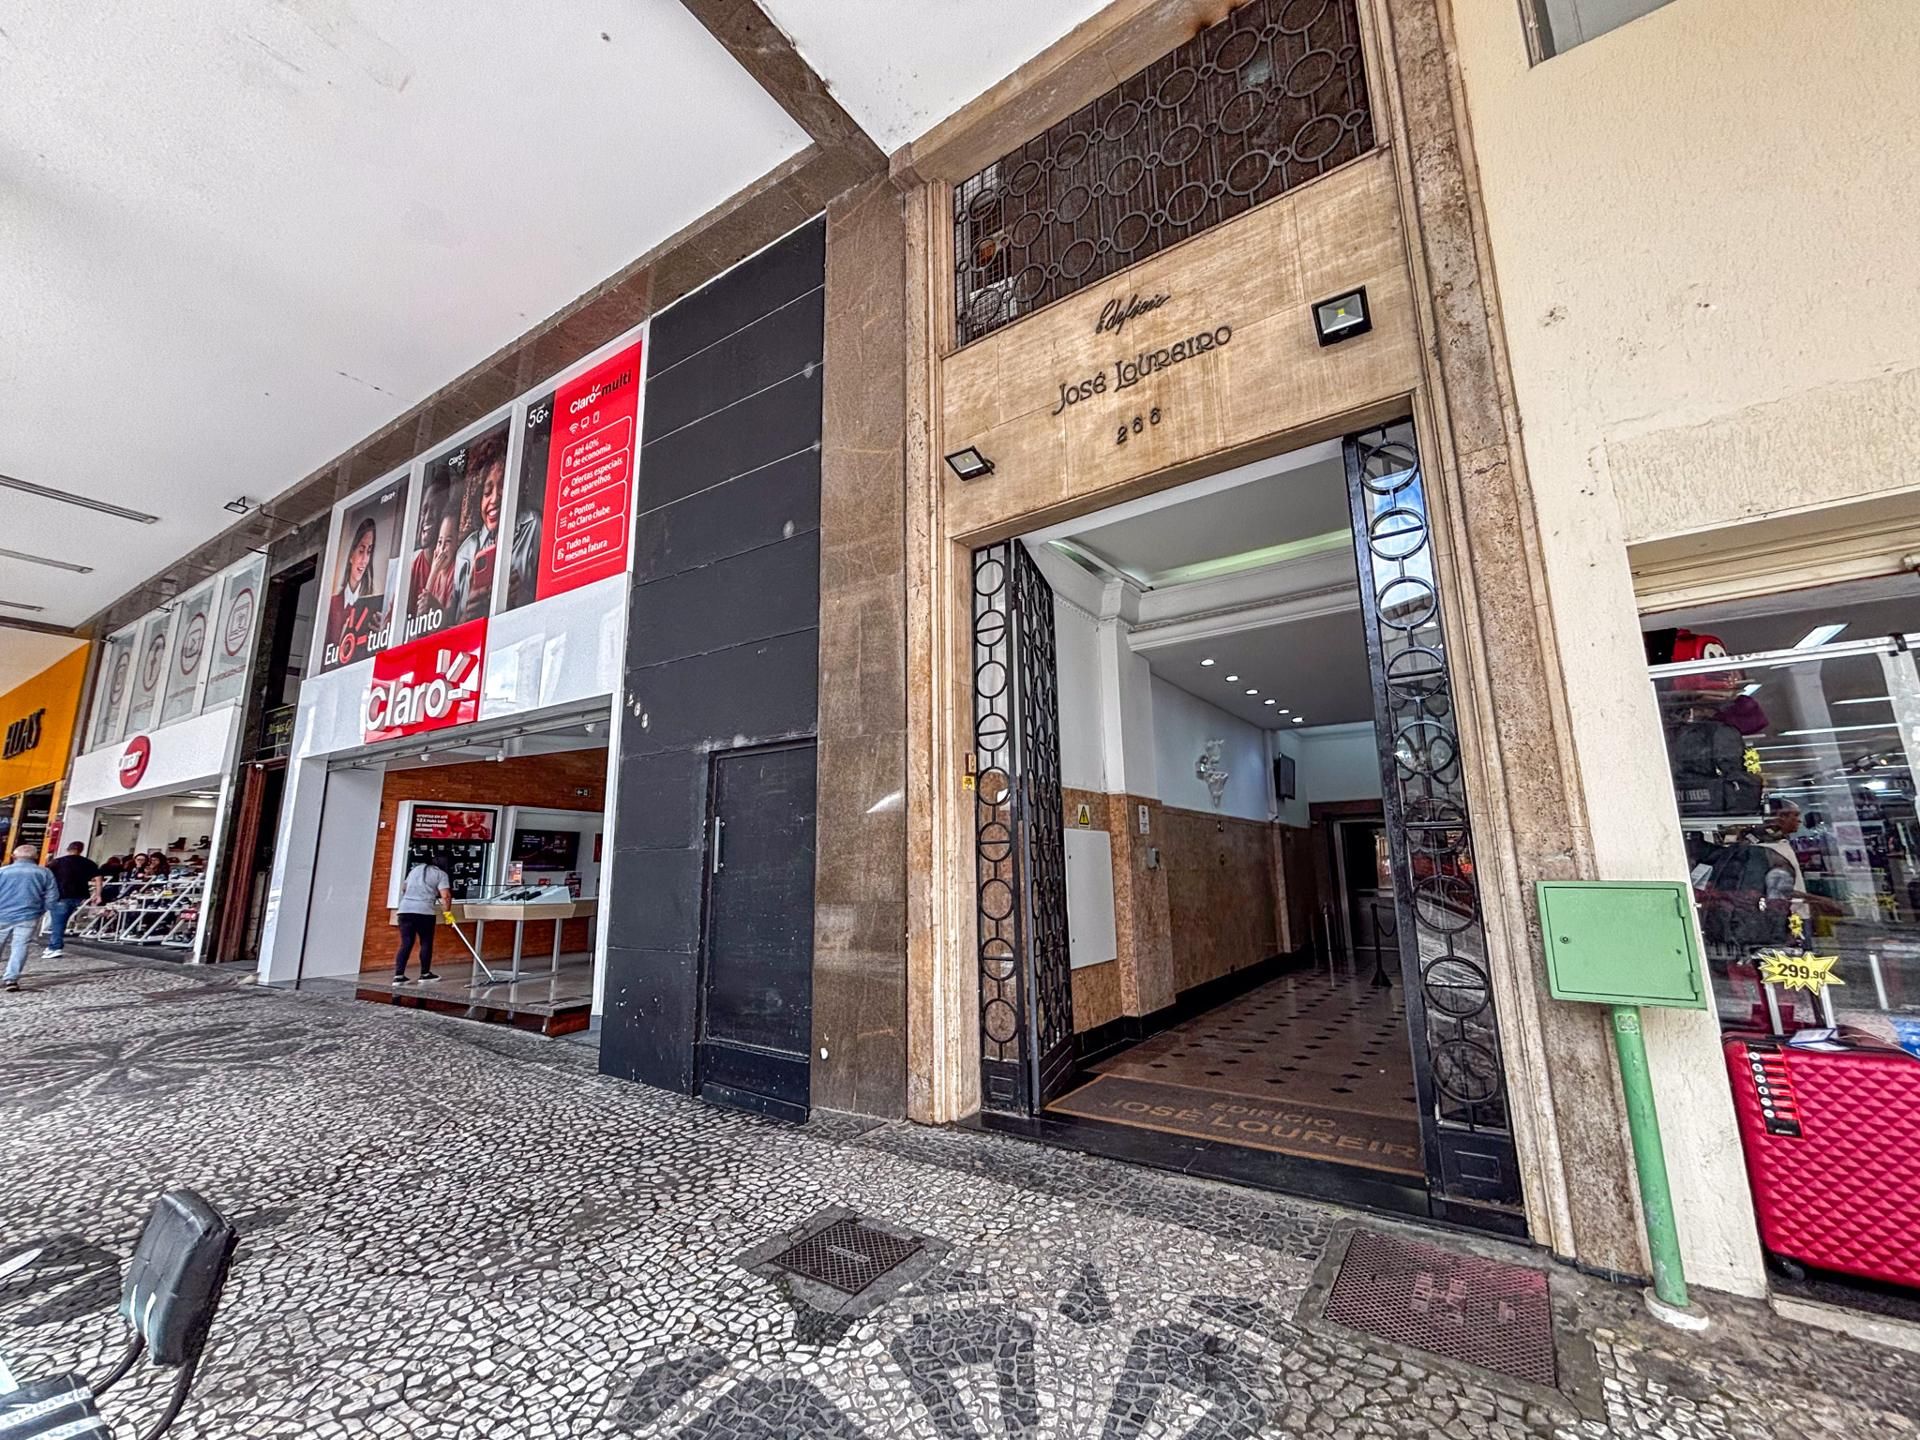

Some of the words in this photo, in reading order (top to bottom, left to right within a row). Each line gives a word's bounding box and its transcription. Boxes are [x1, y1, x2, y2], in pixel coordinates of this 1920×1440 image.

[1114, 325, 1232, 393] LOUREIRO
[570, 392, 597, 414] Claro
[601, 369, 632, 397] multi
[528, 407, 549, 428] 5G+
[1117, 407, 1162, 445] 266
[573, 458, 581, 468] de
[581, 443, 611, 463] economia
[574, 444, 584, 457] Até
[585, 438, 599, 450] 40%
[571, 471, 594, 486] Ofertas
[594, 456, 623, 476] especiais
[570, 488, 580, 497] em
[581, 473, 611, 493] aparelhos
[567, 521, 576, 529] no
[576, 513, 593, 526] Claro
[593, 506, 611, 519] clube
[574, 501, 596, 516] Pontos
[565, 547, 588, 561] mesma
[588, 540, 609, 553] fatura
[566, 538, 582, 550] Tudo
[582, 535, 591, 544] na
[324, 643, 339, 665] Eu
[367, 622, 390, 651] tud
[404, 607, 442, 645] junto
[366, 671, 452, 731] Claro
[1210, 1114, 1416, 1160] LOUREIR
